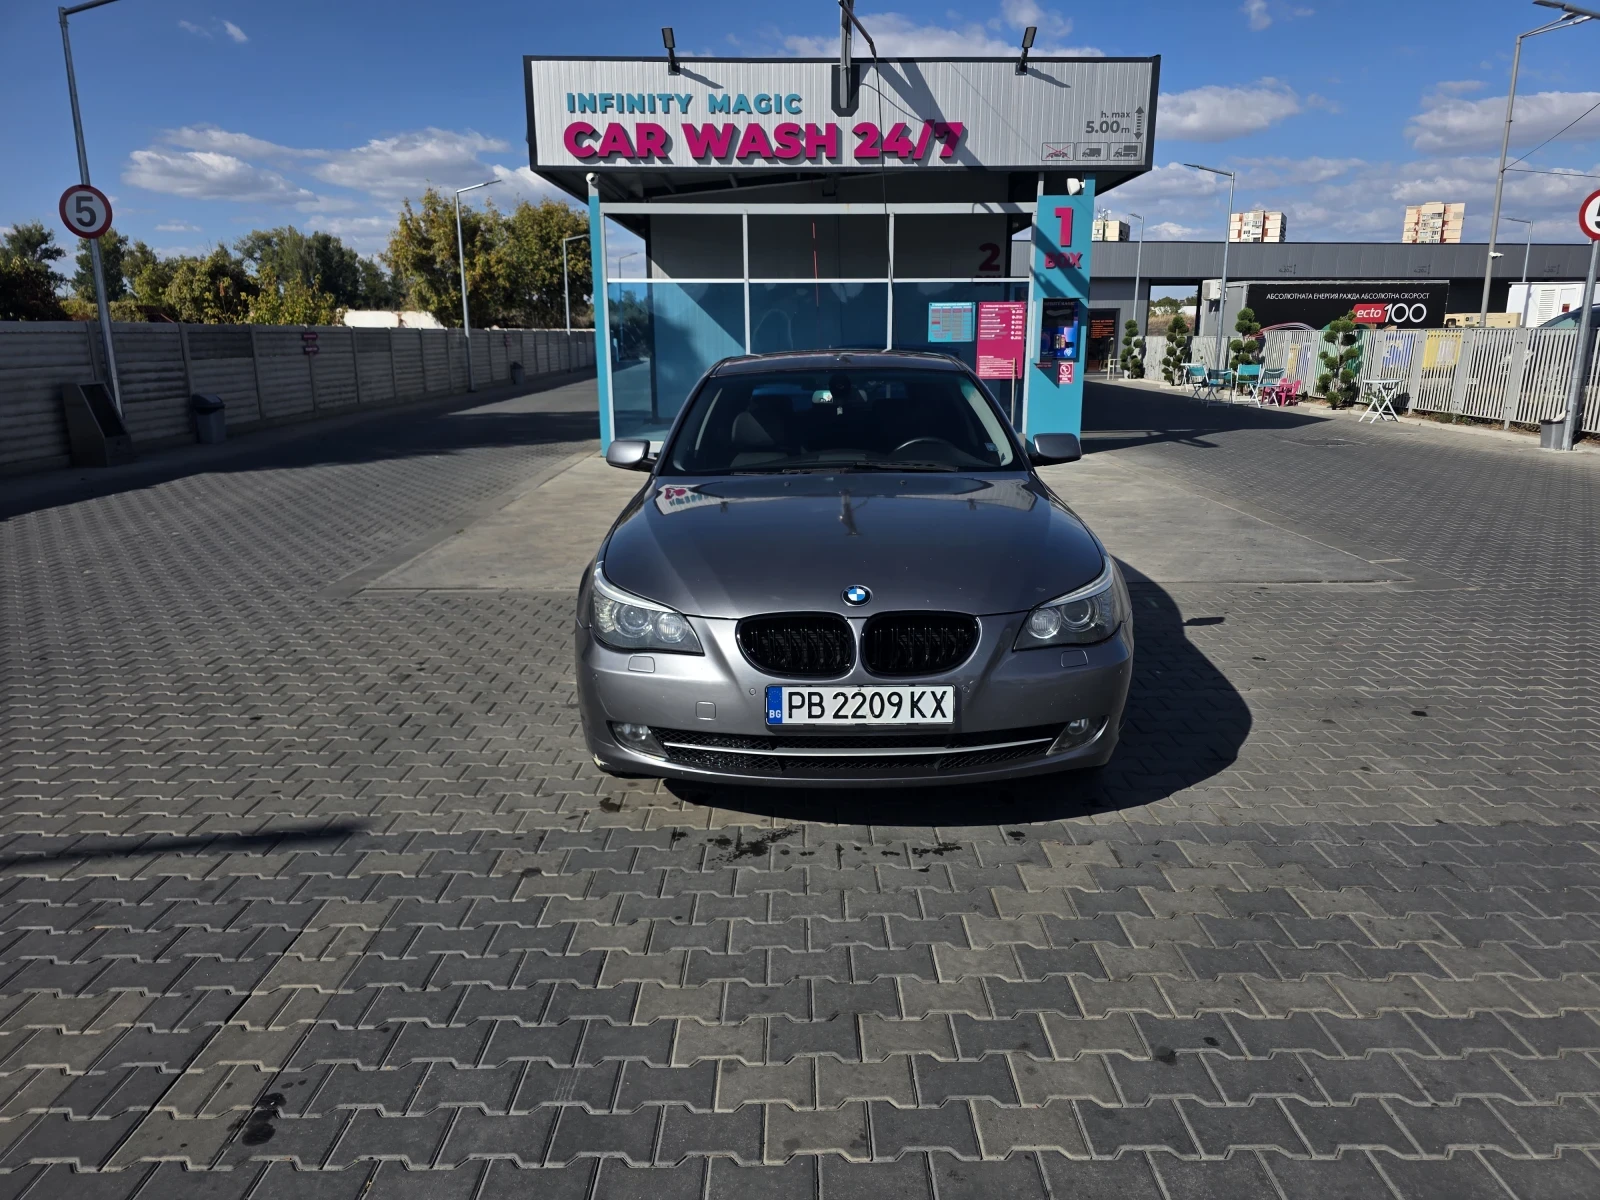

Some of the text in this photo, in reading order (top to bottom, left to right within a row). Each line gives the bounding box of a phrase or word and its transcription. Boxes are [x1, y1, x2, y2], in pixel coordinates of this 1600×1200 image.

[566, 92, 802, 114] INFINITY MAGIC
[563, 118, 964, 160] CAR WASH 24/7
[75, 195, 97, 228] 5
[1054, 207, 1073, 246] 1
[978, 242, 1001, 272] 2
[1045, 251, 1083, 269] BOX
[1266, 292, 1430, 300] АБСОЛЮТНАТА ЕНЕРГИЯ РАЖДА АБСОЛЮТНА СКОРОСТ
[769, 690, 948, 720] BG PB 2209 KX
